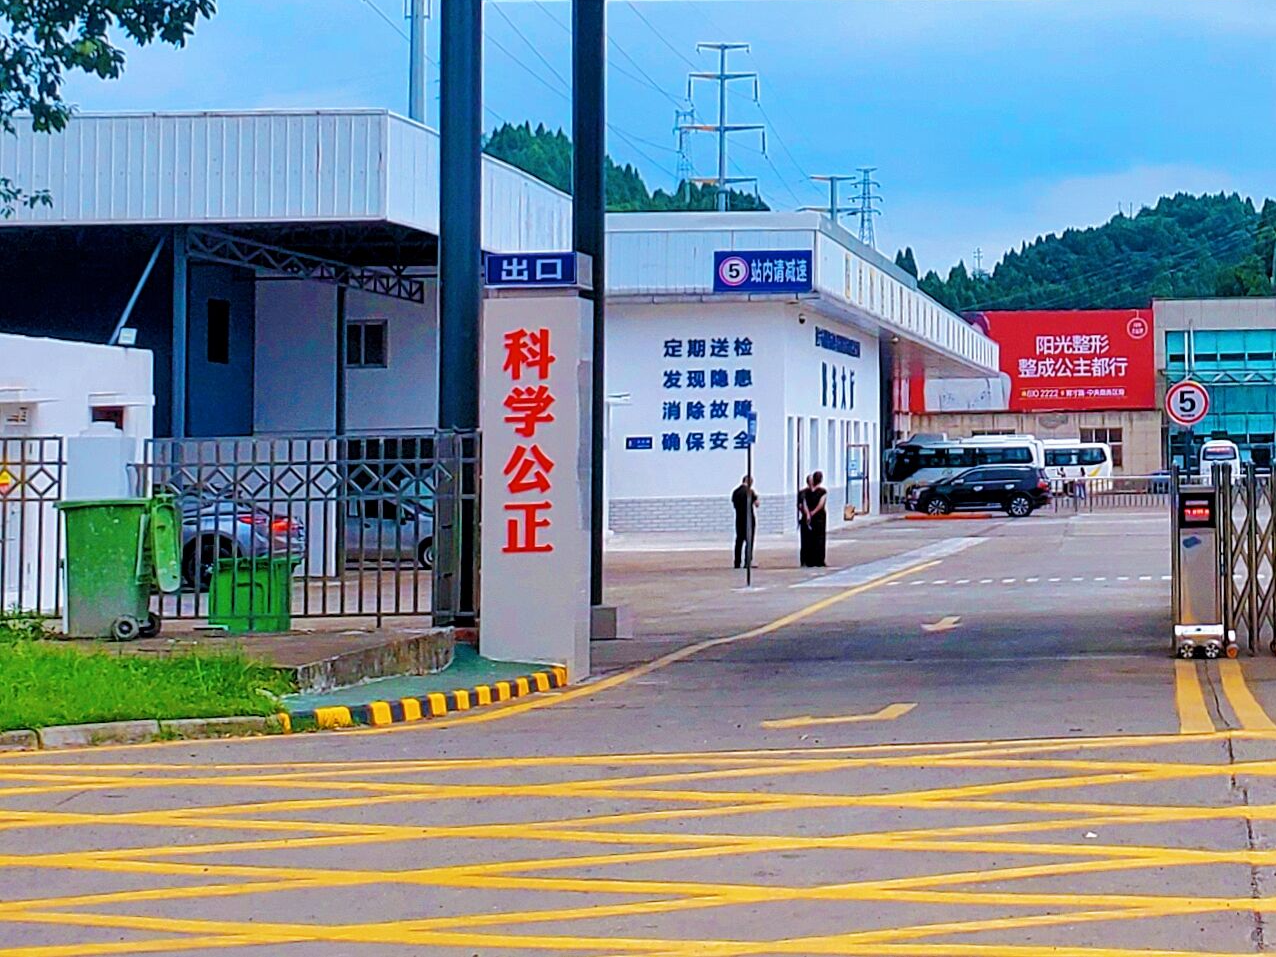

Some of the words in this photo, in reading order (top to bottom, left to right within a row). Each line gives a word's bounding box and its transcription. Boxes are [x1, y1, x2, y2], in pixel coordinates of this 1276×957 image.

[501, 258, 562, 281] 出口
[729, 264, 740, 278] 5
[751, 258, 807, 283] 站内请减速
[663, 337, 753, 357] 定期送检
[1036, 334, 1109, 355] 阳光整形
[1018, 357, 1128, 378] 整成公主都行
[663, 369, 753, 389] 发现隐患
[662, 400, 752, 420] 消除故障
[1179, 390, 1196, 413] 5
[502, 328, 555, 554] 科学公正
[662, 430, 752, 452] 确保安全
